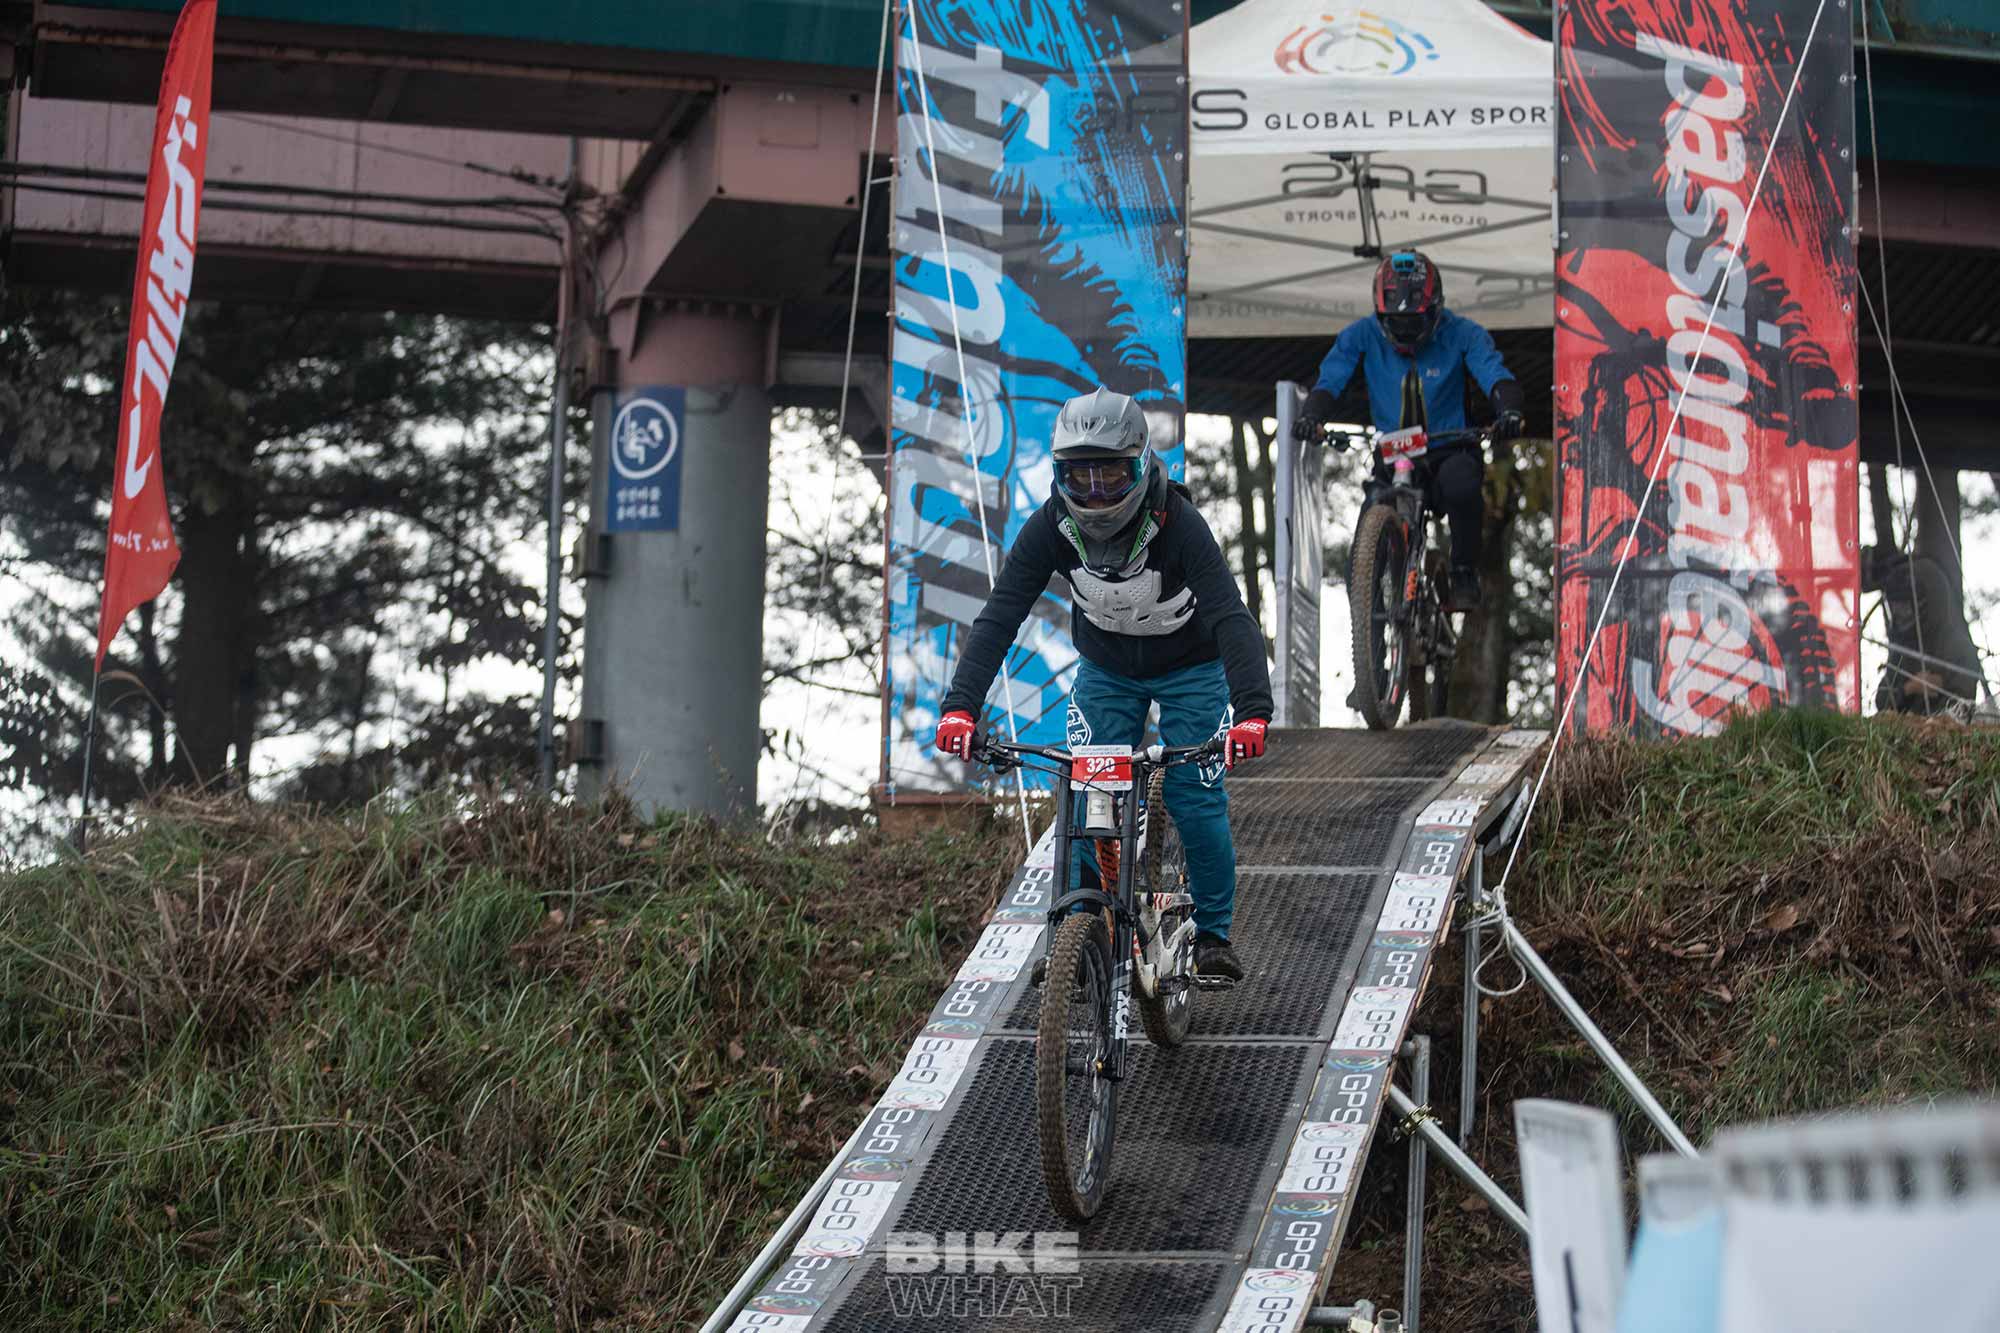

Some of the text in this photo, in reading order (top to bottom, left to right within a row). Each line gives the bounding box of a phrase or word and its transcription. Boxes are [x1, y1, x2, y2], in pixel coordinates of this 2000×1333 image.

[1264, 111, 1375, 130] GLOBAL
[1388, 109, 1456, 127] PLAY
[1471, 106, 1554, 125] SPOR
[1632, 31, 1787, 739] passionately
[1086, 757, 1116, 773] 320
[1418, 842, 1455, 876] GPS
[1011, 868, 1053, 906] GPS
[1400, 896, 1436, 929] GPS
[979, 926, 1022, 959] GPS
[1378, 951, 1418, 987] GPS
[944, 981, 991, 1017] GPS
[1355, 1009, 1396, 1049] GPS
[905, 1039, 954, 1084] GPS
[1329, 1073, 1373, 1124] GPS
[863, 1108, 915, 1154] GPS
[1303, 1146, 1347, 1191] GPS
[822, 1181, 875, 1231] GPS
[1275, 1221, 1322, 1271] GPS
[775, 1255, 832, 1294] GPS
